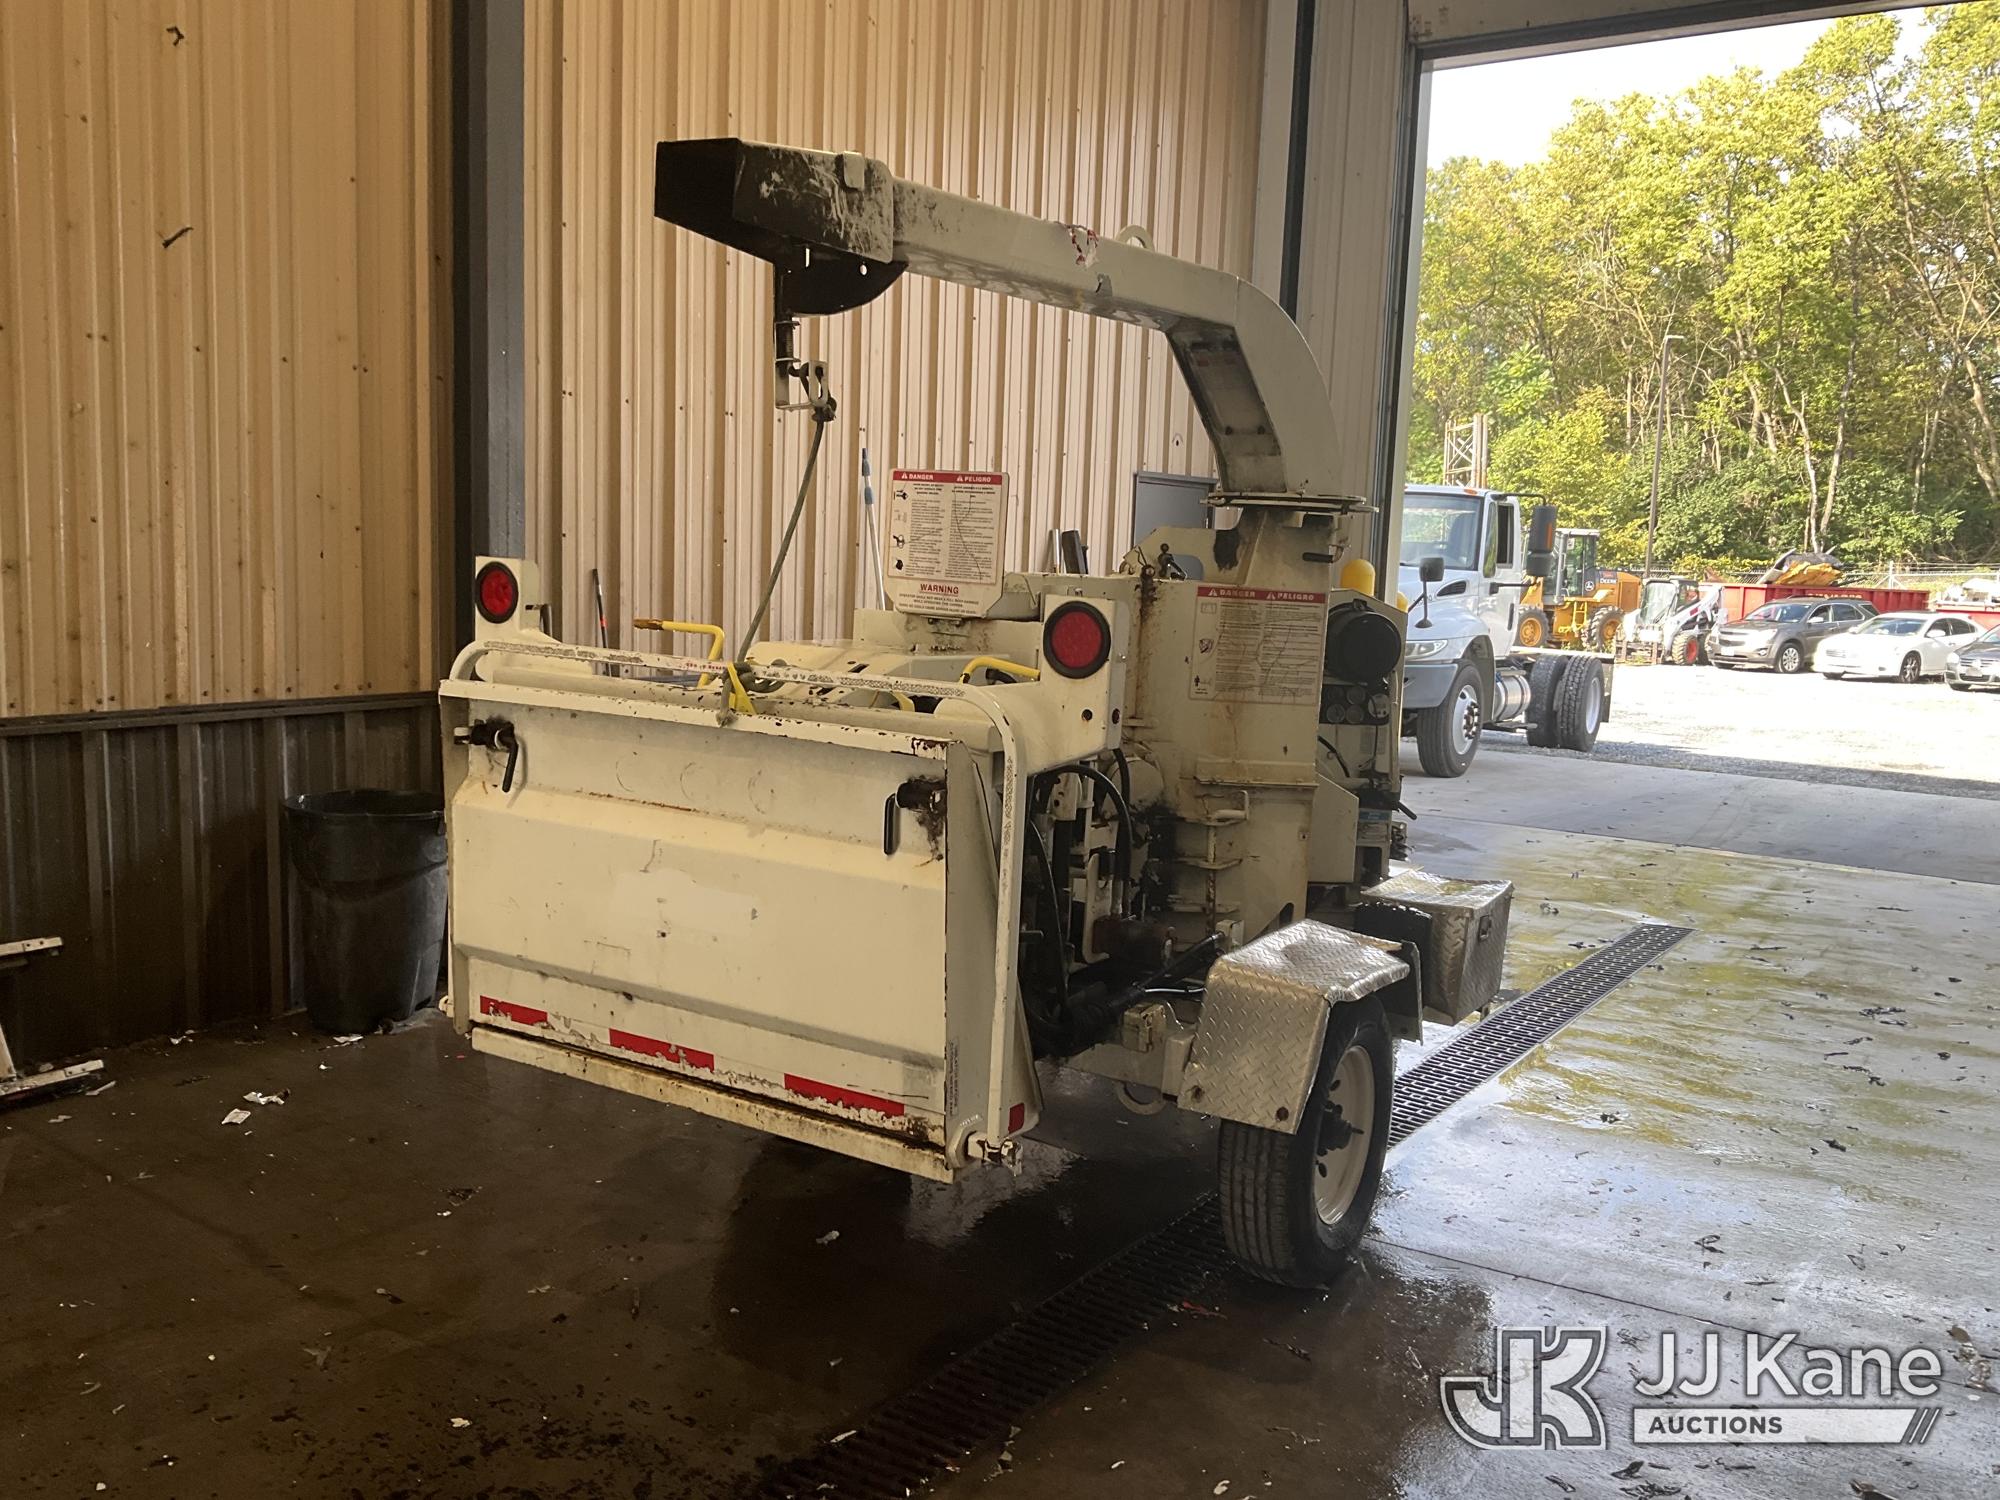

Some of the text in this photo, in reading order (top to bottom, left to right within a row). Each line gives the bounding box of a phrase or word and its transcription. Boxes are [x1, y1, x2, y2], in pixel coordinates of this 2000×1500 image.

[920, 583, 959, 594] WARNING
[1220, 589, 1256, 598] DANGER
[1277, 592, 1315, 601] PELIGRO
